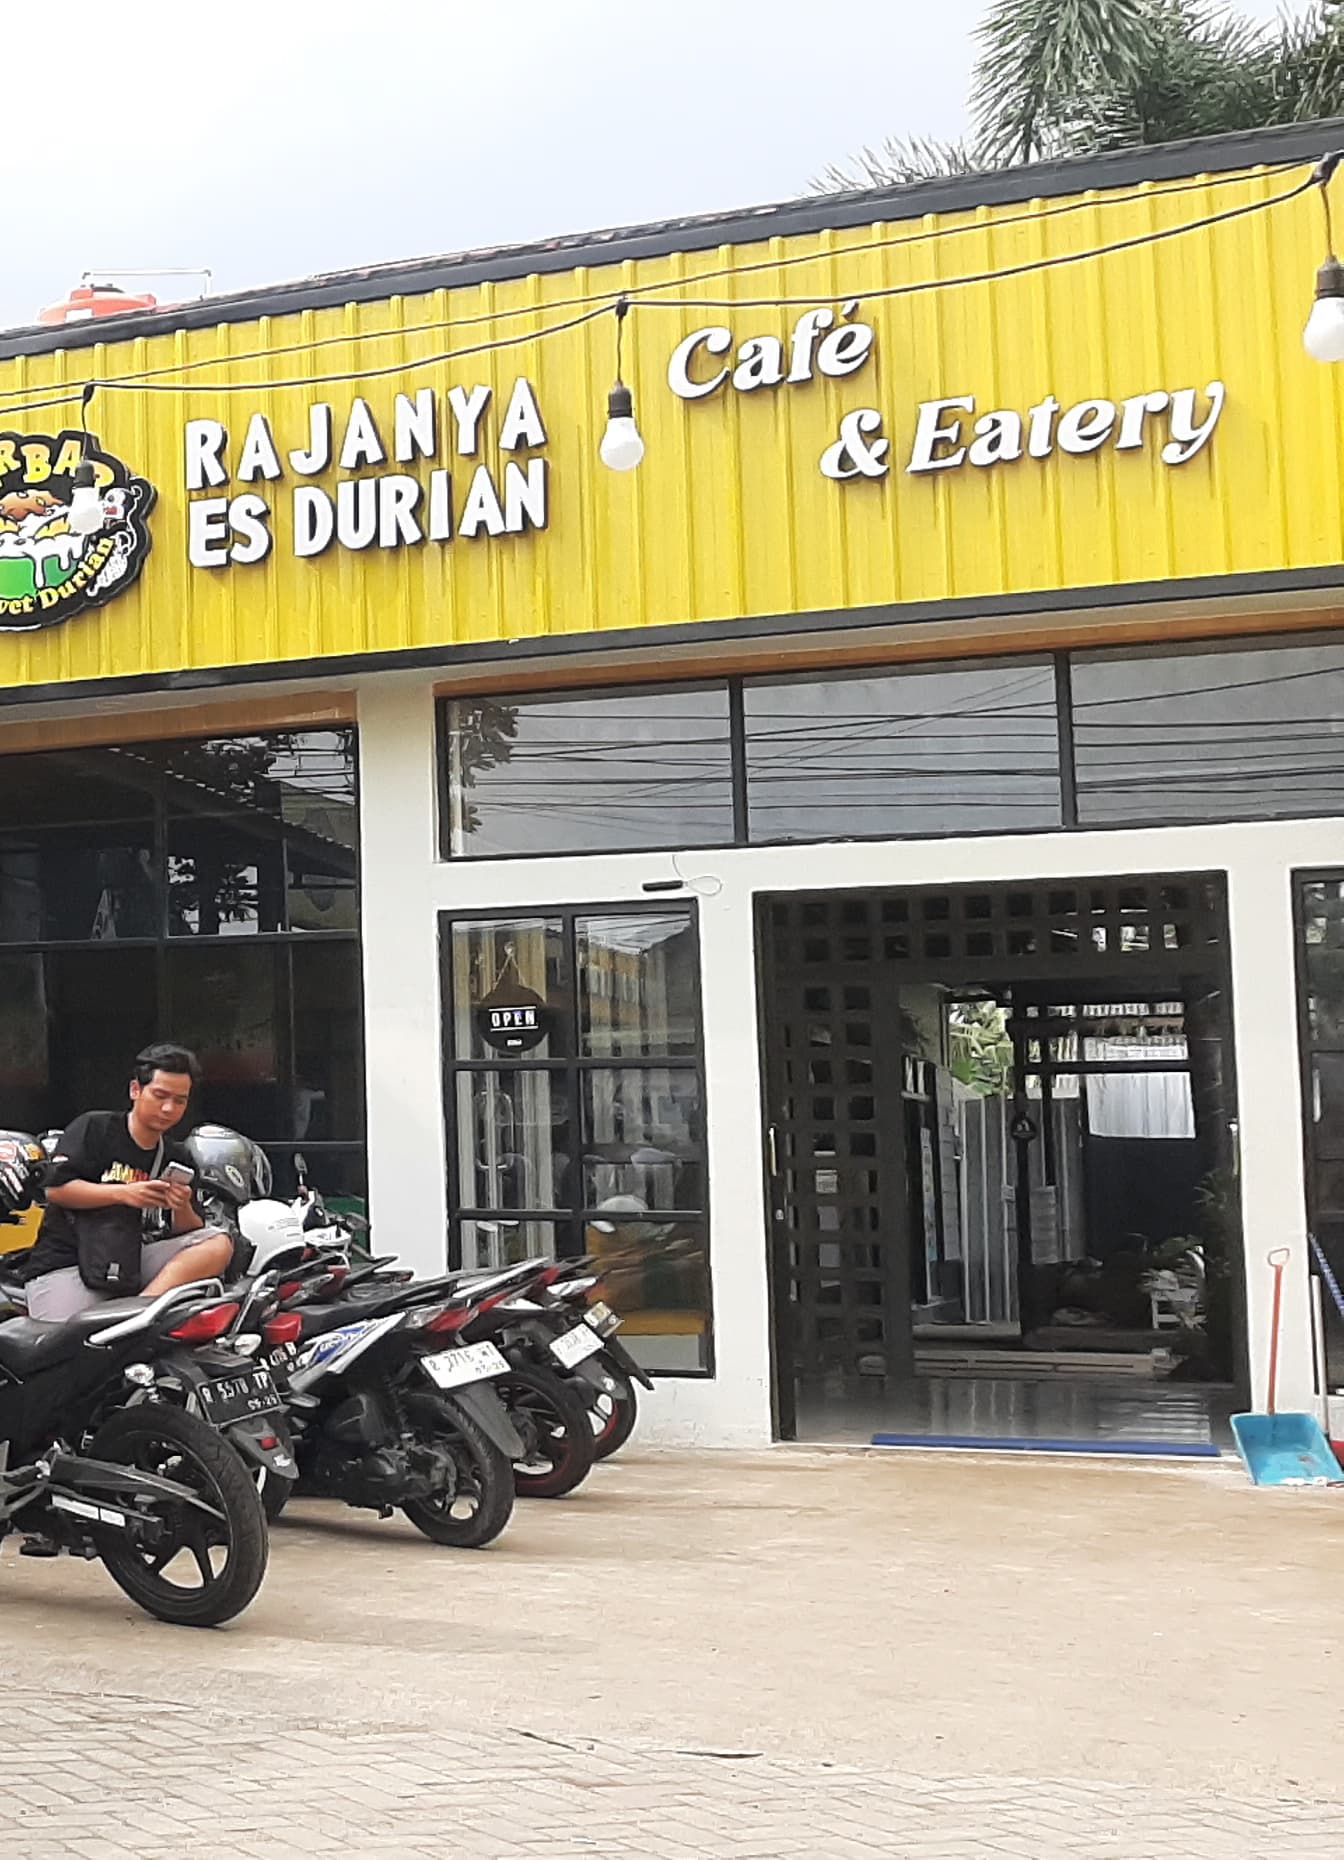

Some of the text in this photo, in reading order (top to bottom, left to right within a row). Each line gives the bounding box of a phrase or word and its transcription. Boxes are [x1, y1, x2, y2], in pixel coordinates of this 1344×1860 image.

[667, 300, 875, 401] Café
[184, 375, 547, 490] RAJANYA
[818, 379, 1226, 479] & Eatery
[188, 457, 547, 569] ES DURIAN
[37, 537, 116, 609] Durian
[491, 1010, 535, 1028] OPEN
